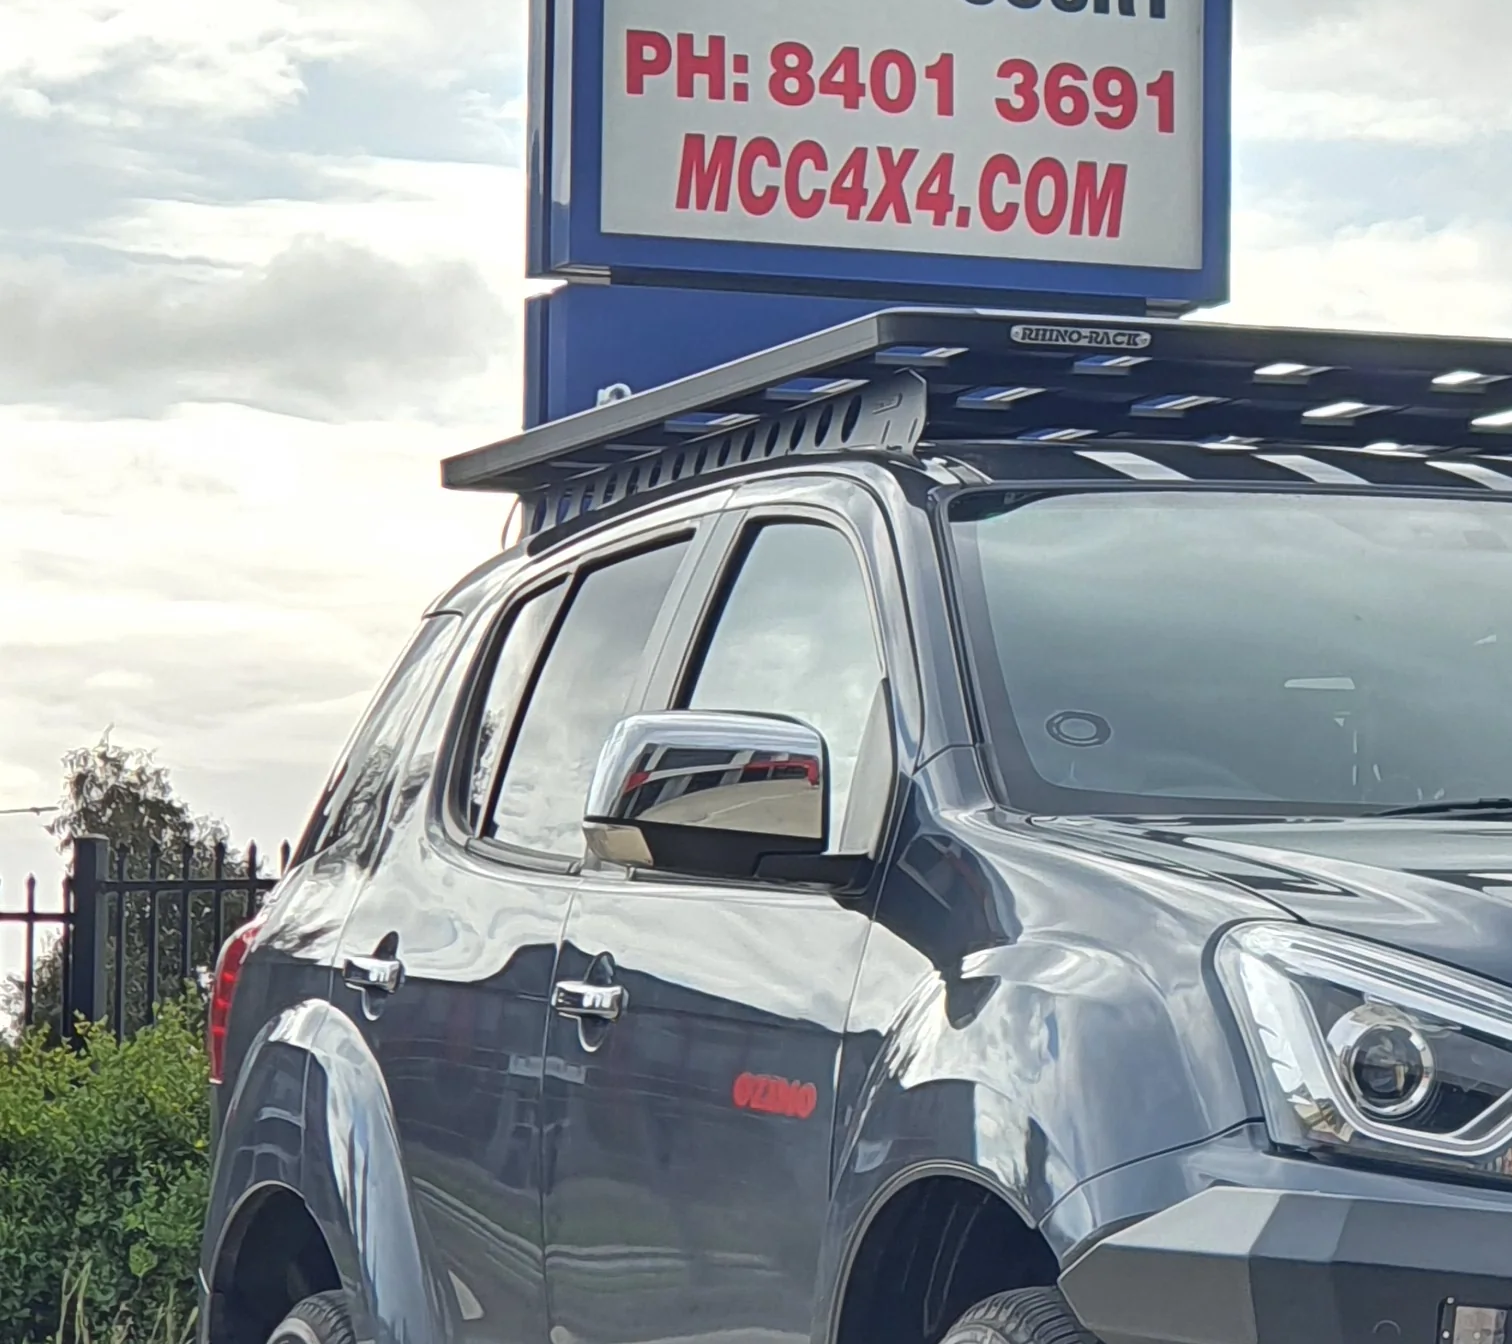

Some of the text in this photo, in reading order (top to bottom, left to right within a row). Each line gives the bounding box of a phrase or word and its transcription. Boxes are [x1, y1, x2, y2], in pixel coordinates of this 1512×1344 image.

[625, 28, 1176, 134] PH: 8401 3691
[675, 132, 1128, 239] MCC4X4.COM
[1020, 327, 1141, 347] RHINO-RACK
